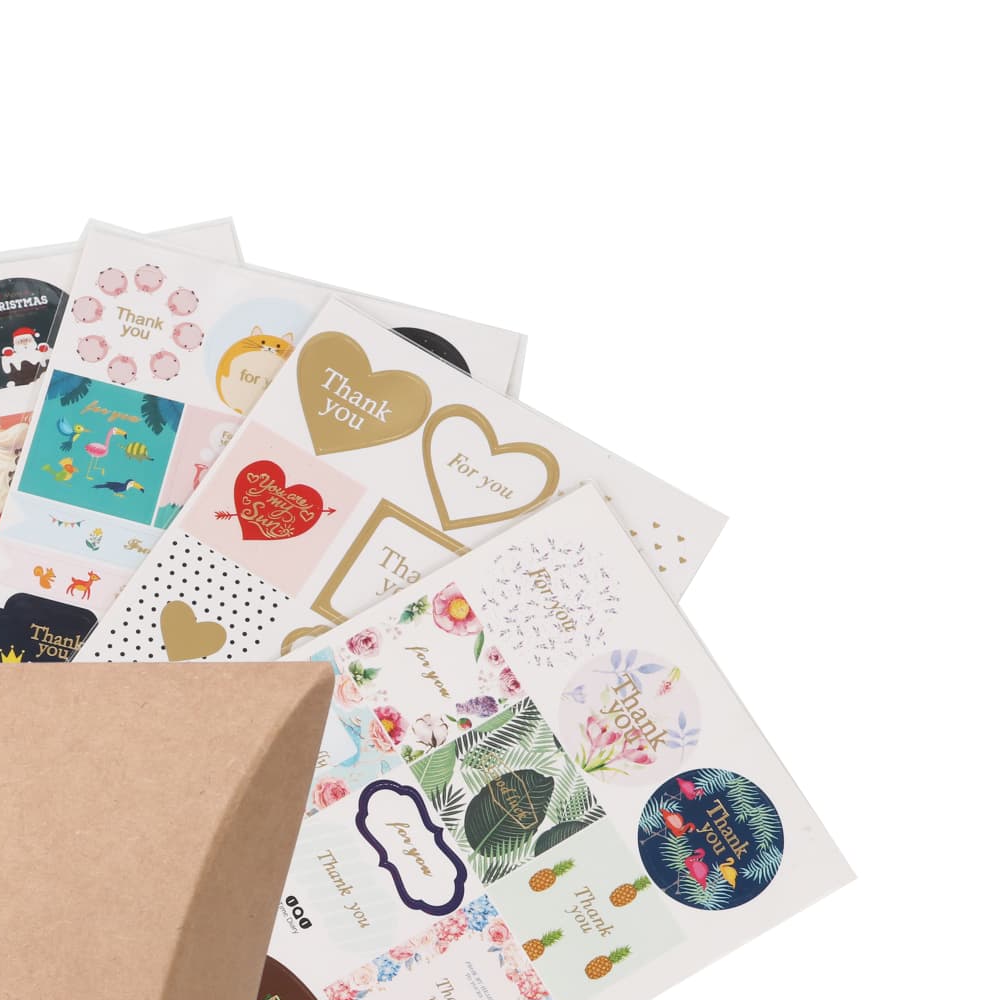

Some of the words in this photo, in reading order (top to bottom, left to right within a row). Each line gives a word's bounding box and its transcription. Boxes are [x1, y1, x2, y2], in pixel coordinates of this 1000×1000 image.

[117, 306, 165, 330] Thank
[120, 323, 152, 340] you
[240, 369, 261, 384] for
[321, 367, 393, 424] Thank
[318, 398, 366, 432] you
[246, 473, 287, 497] You
[448, 452, 480, 481] For
[478, 474, 515, 500] you
[241, 501, 288, 537] Sun
[265, 496, 295, 520] my
[526, 566, 553, 596] For
[546, 594, 577, 633] you
[30, 622, 86, 650] Thank
[36, 641, 70, 662] you
[404, 646, 430, 668] for
[422, 668, 452, 699] you
[600, 698, 642, 745] you
[611, 672, 668, 752] Thank
[696, 820, 727, 856] you
[705, 798, 750, 860] Thank
[386, 821, 413, 845] for
[402, 845, 433, 878] you
[316, 848, 353, 898] Thank
[343, 900, 371, 930] you
[564, 902, 593, 935] you
[574, 886, 615, 938] Thank
